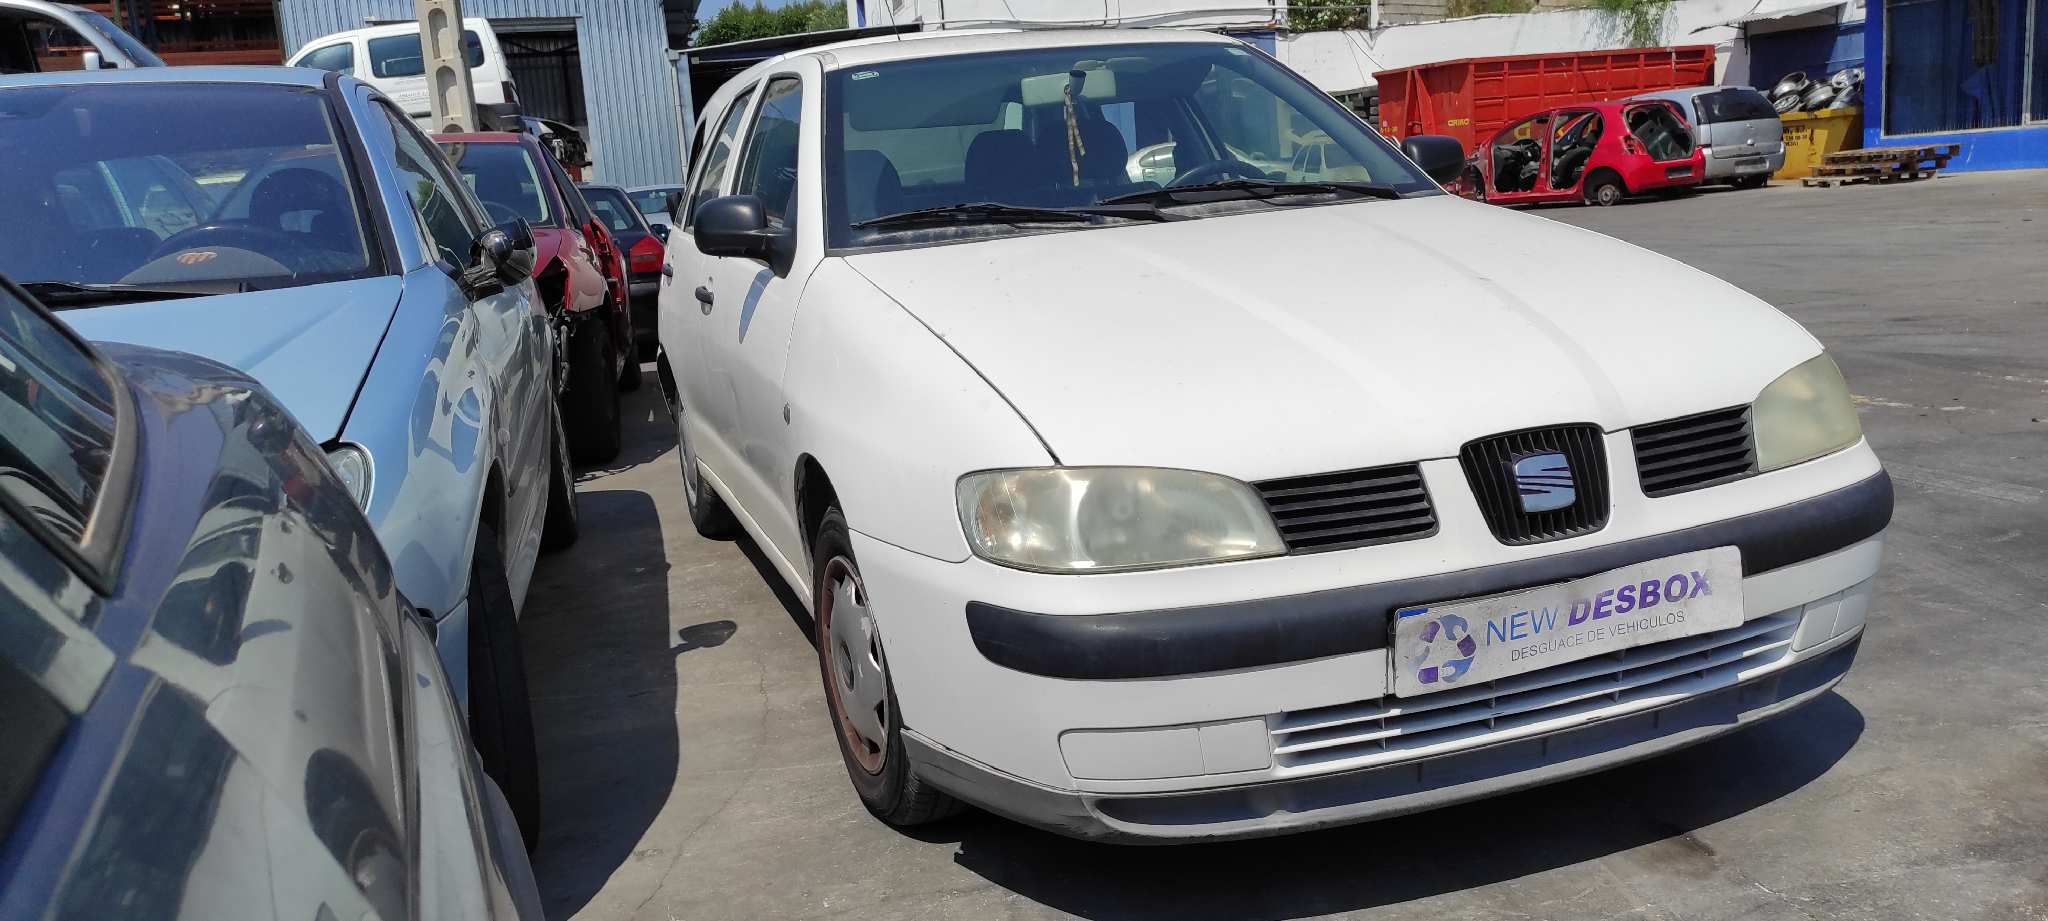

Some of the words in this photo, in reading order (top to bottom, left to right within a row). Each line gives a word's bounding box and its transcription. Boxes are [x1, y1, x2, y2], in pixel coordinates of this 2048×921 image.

[1486, 606, 1559, 646] NEW
[1567, 569, 1713, 627] DESBOX
[1511, 632, 1584, 661] DESGUACE
[1587, 627, 1605, 643] DE
[1608, 610, 1685, 637] VEHICULOS
